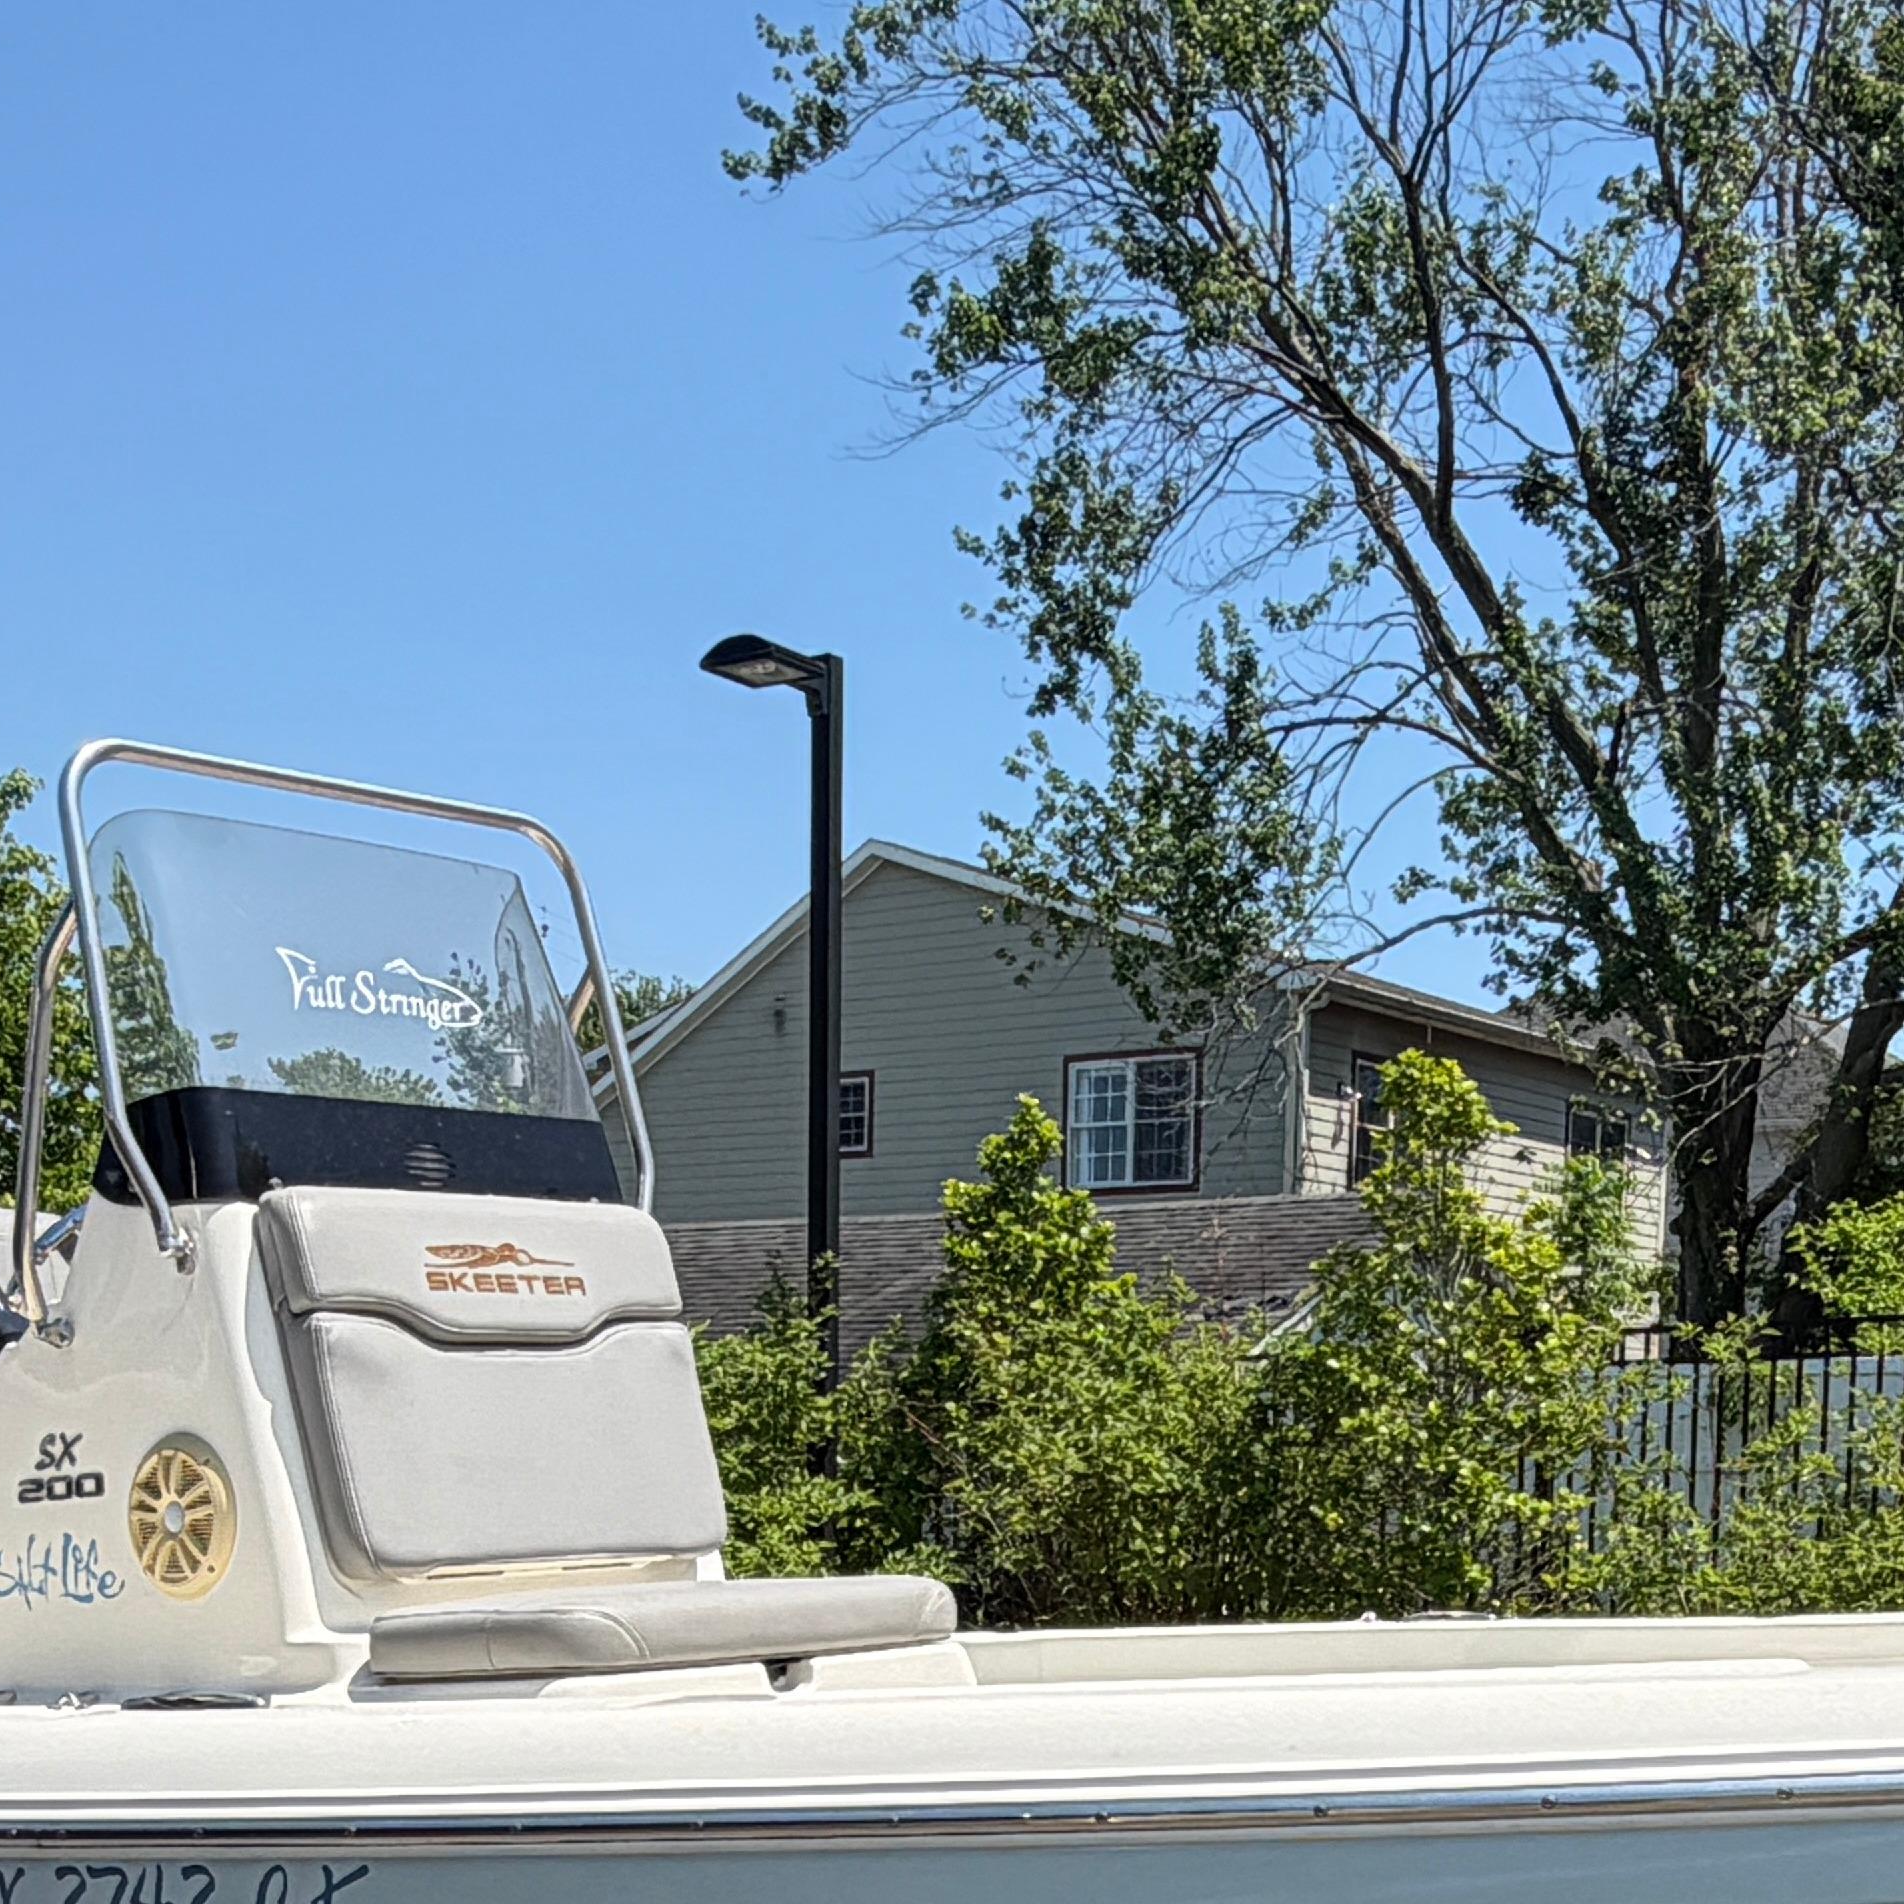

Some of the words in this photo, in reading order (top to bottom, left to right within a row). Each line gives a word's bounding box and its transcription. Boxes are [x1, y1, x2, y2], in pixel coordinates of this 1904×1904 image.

[275, 946, 346, 1011] Full
[425, 1271, 587, 1297] SKEETER
[34, 1432, 84, 1472] SX
[17, 1472, 105, 1504] 200
